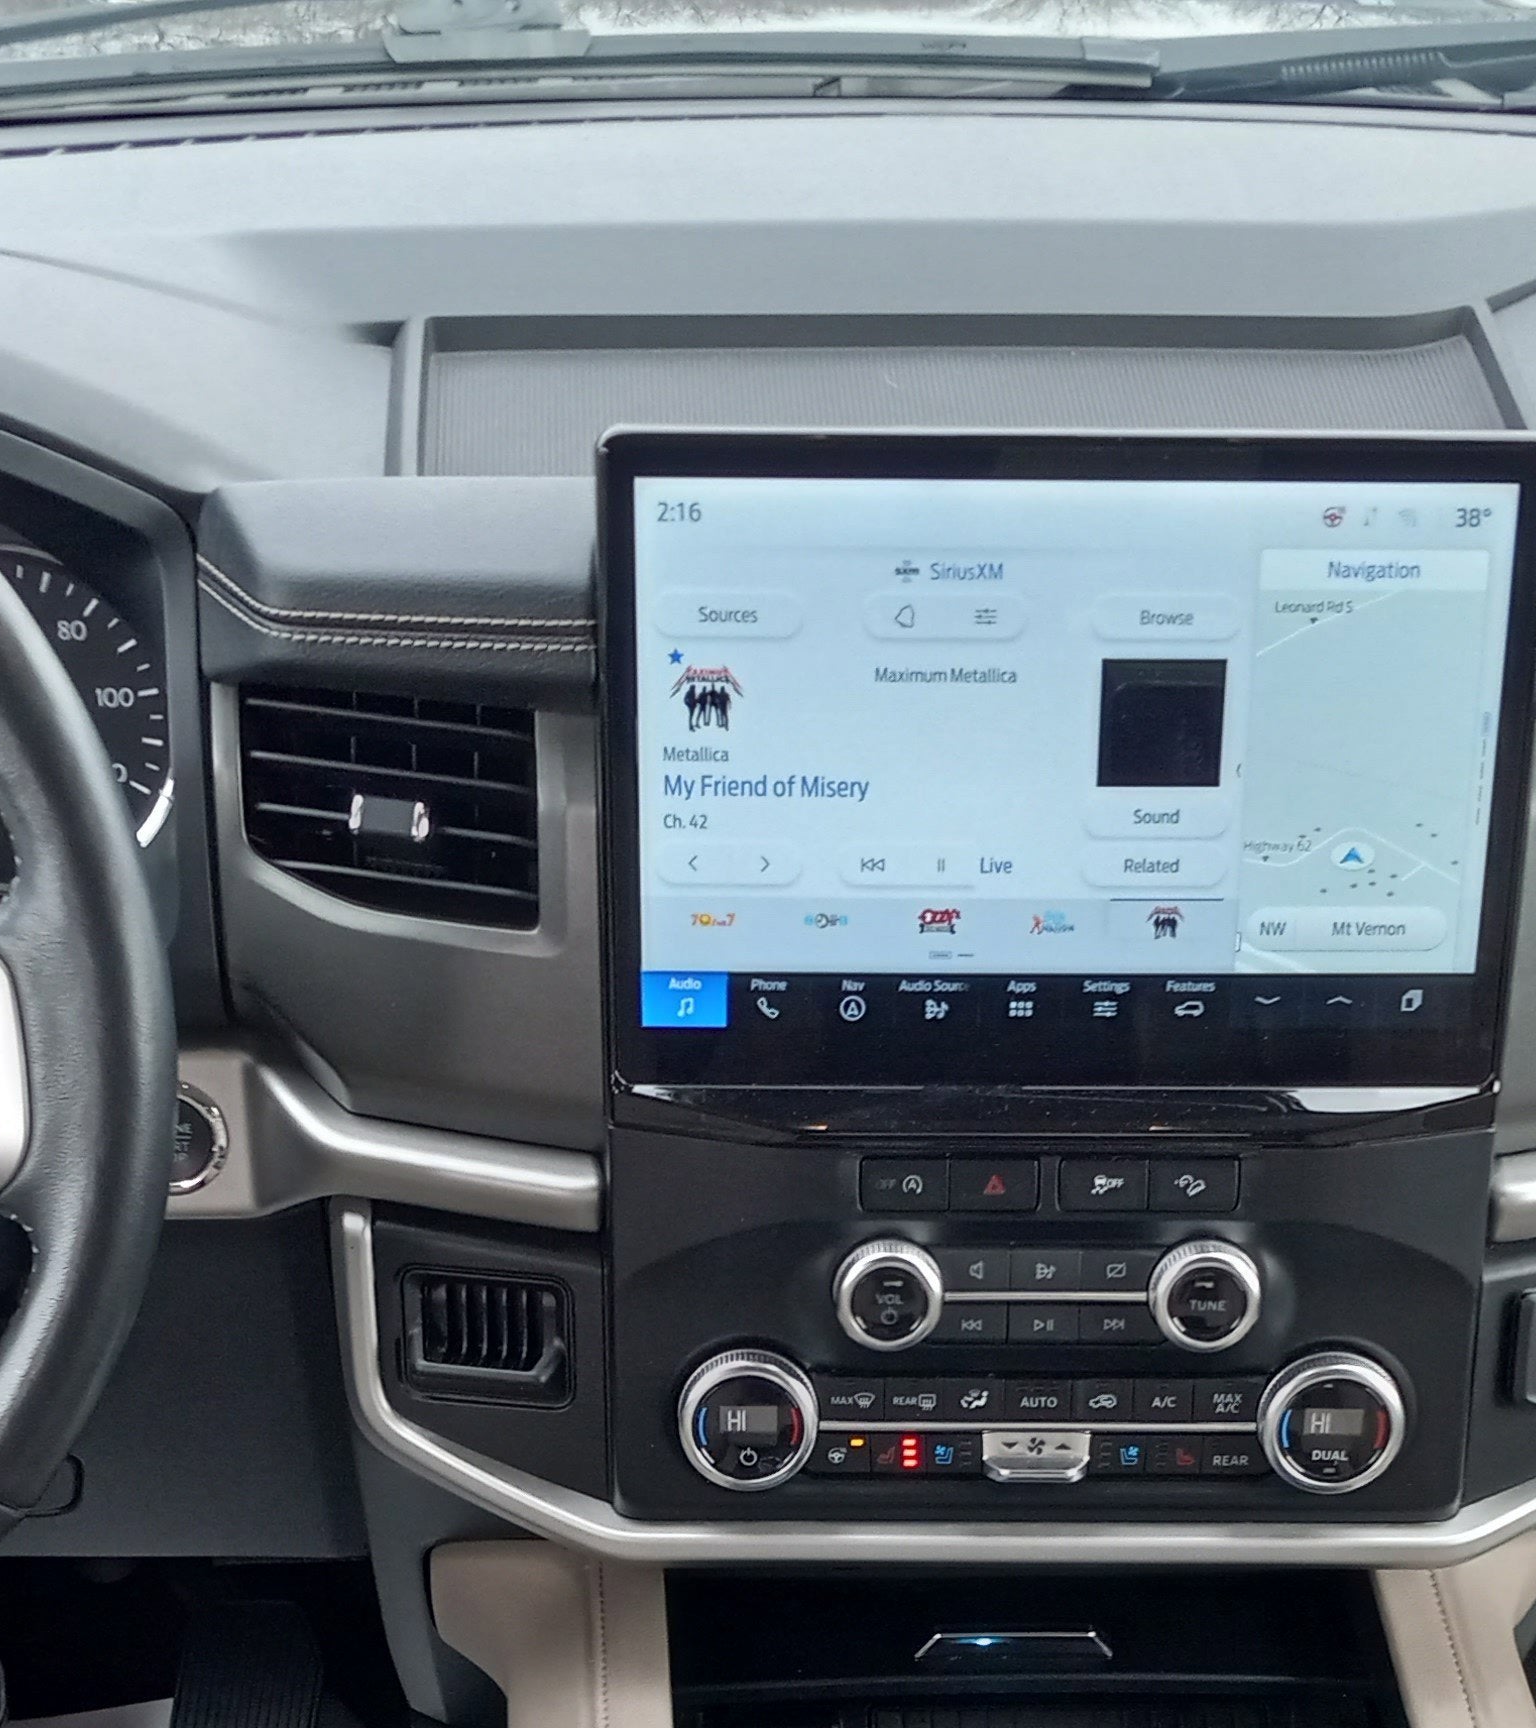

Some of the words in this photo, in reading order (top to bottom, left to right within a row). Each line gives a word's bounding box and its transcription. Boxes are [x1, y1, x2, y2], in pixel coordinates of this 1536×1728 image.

[657, 502, 702, 522] 2:16
[1455, 508, 1493, 528] 38°
[930, 562, 1003, 580] SiriusXM
[1328, 561, 1420, 581] Navigation
[1275, 601, 1324, 613] Leonard
[1326, 601, 1342, 613] Rd
[698, 607, 758, 623] Sources
[1139, 611, 1193, 626] Browse
[56, 620, 87, 641] 80
[875, 668, 947, 682] Maximum
[950, 668, 1016, 683] Metallica
[95, 687, 135, 708] 100
[663, 746, 729, 762] Metallica
[664, 775, 694, 801] My
[701, 774, 766, 797] Friend
[773, 774, 795, 797] of
[801, 775, 870, 801] Misery
[664, 814, 686, 829] Ch.
[690, 814, 708, 829] 42
[1133, 809, 1180, 825] Sound
[1243, 841, 1293, 853] Highway
[1297, 840, 1312, 852] 62
[980, 858, 1013, 874] Live
[1123, 859, 1180, 874] Related
[1259, 922, 1286, 936] NW
[1331, 922, 1352, 936] Mt
[1357, 922, 1406, 936] Vernon
[669, 977, 702, 990] Audio
[751, 979, 788, 991] Phone
[842, 980, 865, 991] Nav
[898, 979, 932, 992] Audio
[1007, 981, 1037, 994] Apps
[1082, 980, 1131, 994] Settings
[1166, 980, 1215, 993] Features
[875, 1294, 904, 1306] VOL
[1190, 1300, 1226, 1312] TUNE
[830, 1396, 854, 1407] MAX
[893, 1396, 919, 1407] REAR
[1020, 1397, 1058, 1409] AUTO
[1151, 1396, 1177, 1409] A/C
[1213, 1393, 1242, 1404] MAX
[1215, 1403, 1240, 1415] A/C
[727, 1410, 746, 1432] HI
[1311, 1413, 1332, 1435] HI
[1212, 1455, 1249, 1467] REAR
[1311, 1450, 1349, 1462] DUAL
